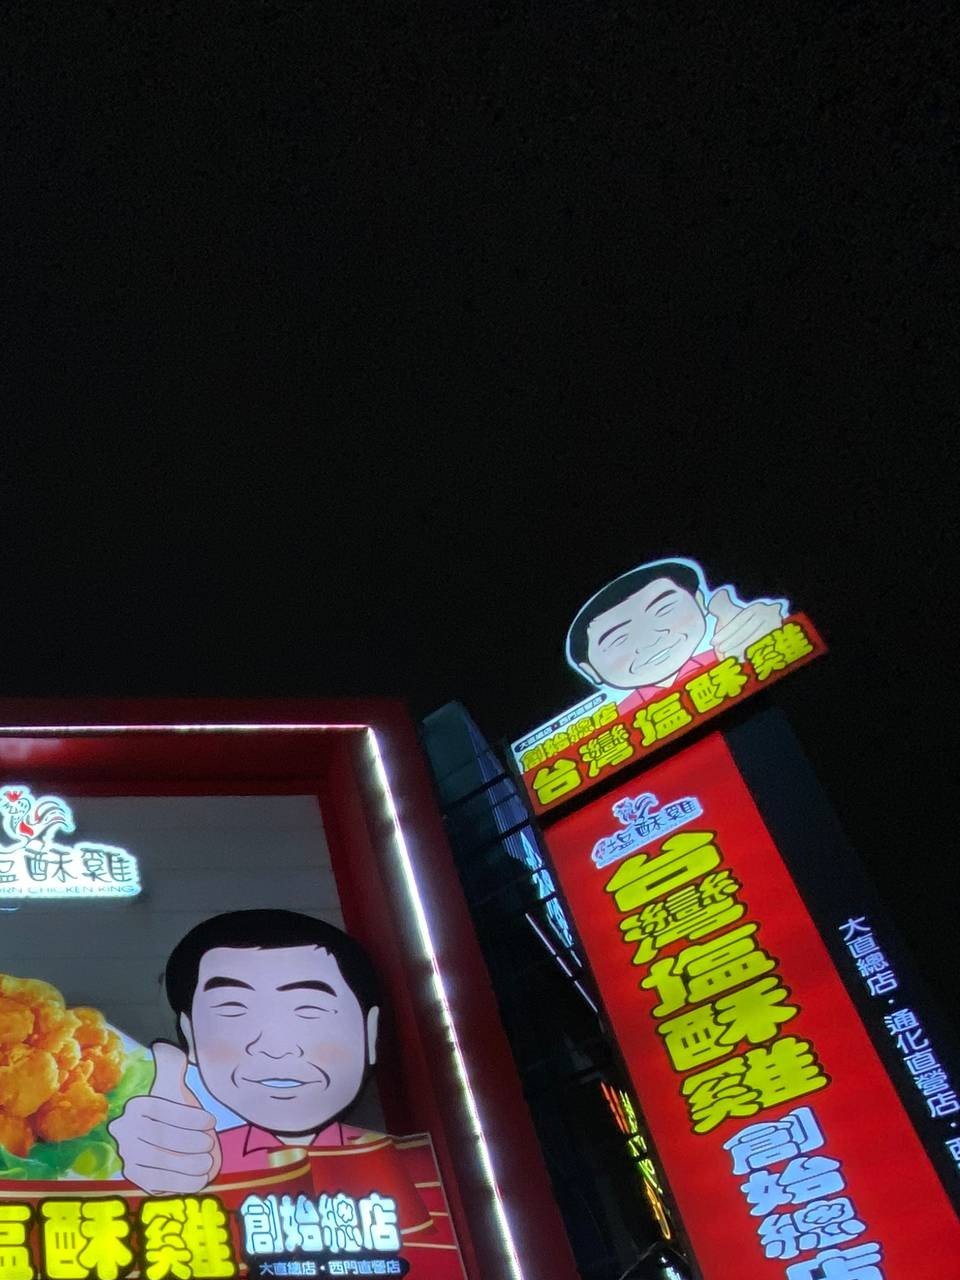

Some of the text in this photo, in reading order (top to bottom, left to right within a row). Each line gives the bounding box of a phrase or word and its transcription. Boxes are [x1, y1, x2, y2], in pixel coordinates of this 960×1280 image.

[532, 622, 814, 805] 台灣塩酥雞
[607, 831, 829, 1134] 台灣塩酥雞
[241, 1193, 400, 1254] 創始總店
